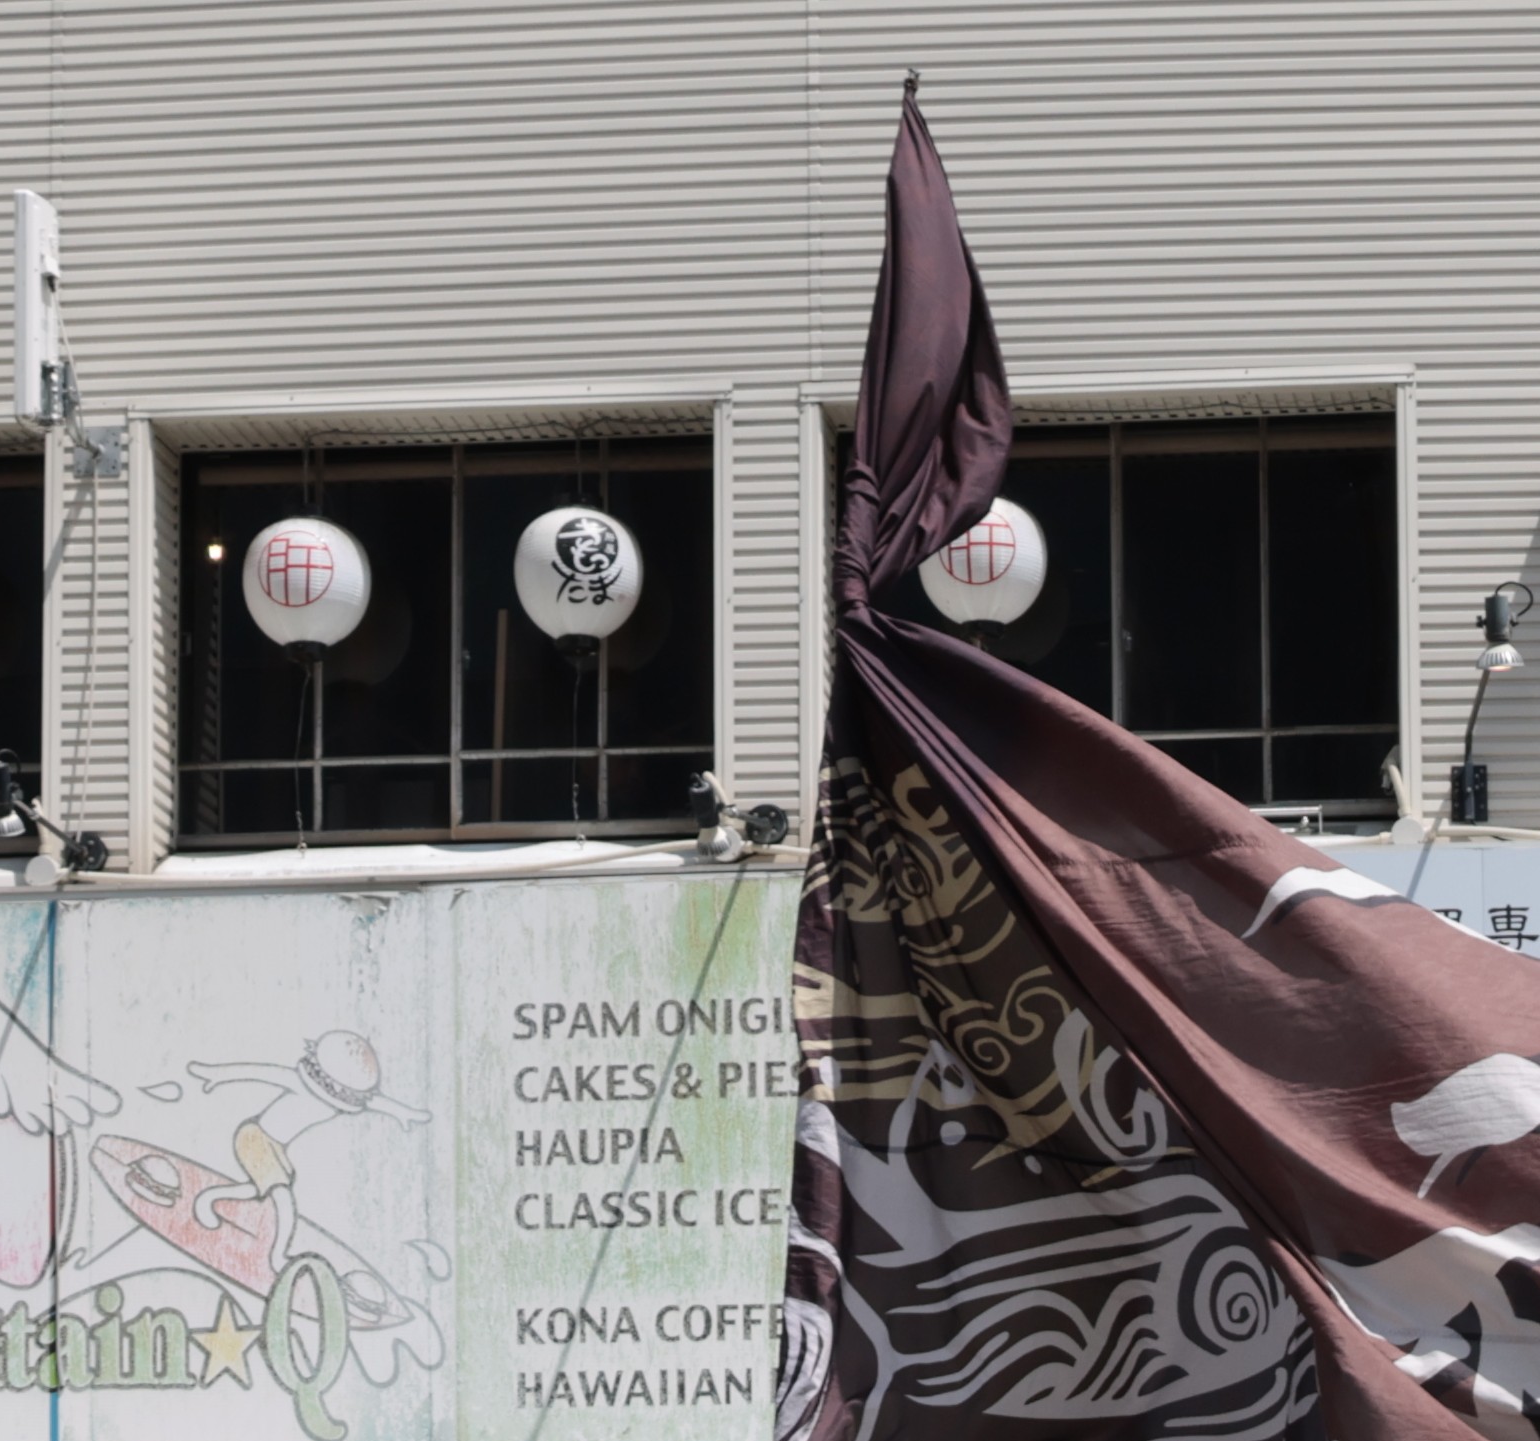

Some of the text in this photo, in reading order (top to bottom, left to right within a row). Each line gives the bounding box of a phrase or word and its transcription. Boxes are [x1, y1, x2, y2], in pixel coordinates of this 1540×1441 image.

[513, 997, 797, 1040] SPAM ONIGI
[513, 1063, 655, 1103] CAKES
[671, 1063, 702, 1099] &
[516, 1127, 684, 1167] HAUPIA
[514, 1189, 697, 1230] CLASSIC
[516, 1307, 641, 1346] KONA
[516, 1368, 752, 1408] HAWAIIAN
